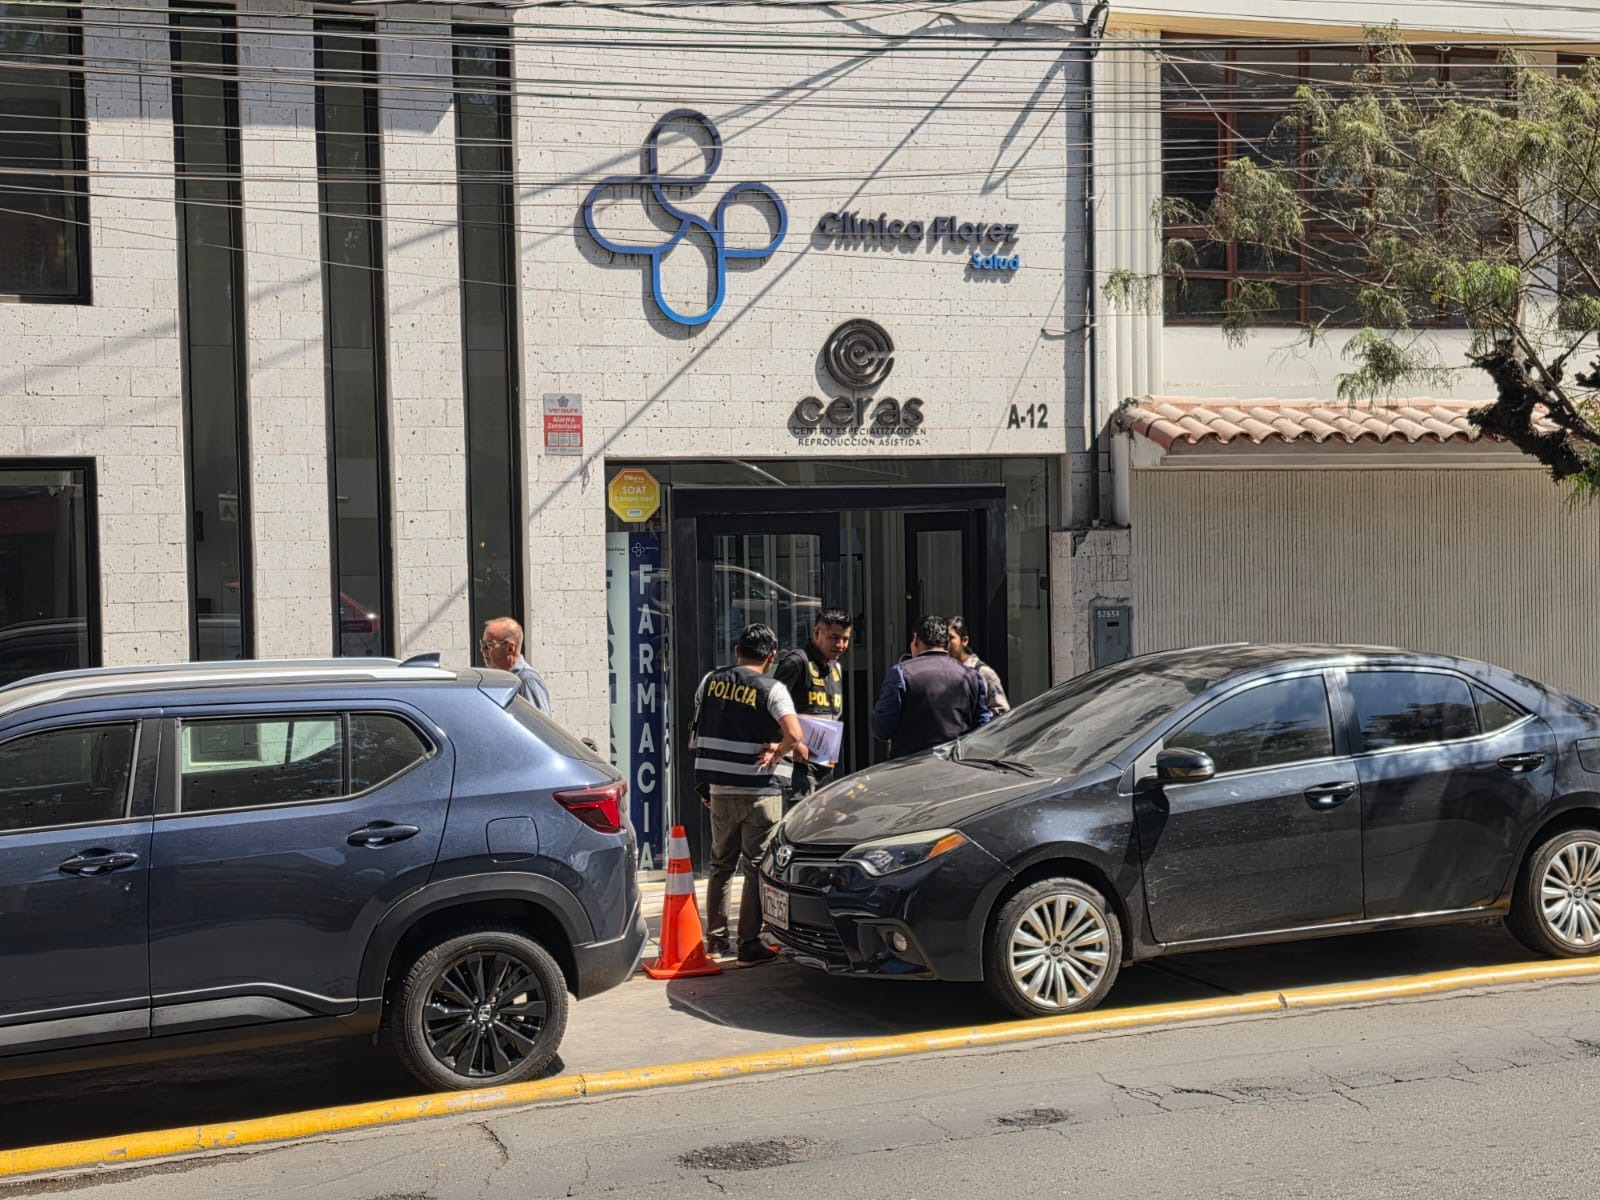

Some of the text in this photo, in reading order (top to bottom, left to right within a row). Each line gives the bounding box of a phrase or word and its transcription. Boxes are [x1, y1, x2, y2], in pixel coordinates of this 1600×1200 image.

[820, 209, 1019, 243] Clínica Florez
[971, 252, 1021, 271] Salud
[794, 396, 924, 427] ceras
[1007, 404, 1049, 429] A-12
[798, 437, 875, 447] REPRODUCCIÓN
[622, 486, 647, 495] SOAT
[707, 680, 758, 708] POLICIA
[637, 563, 657, 870] FARMACIA
